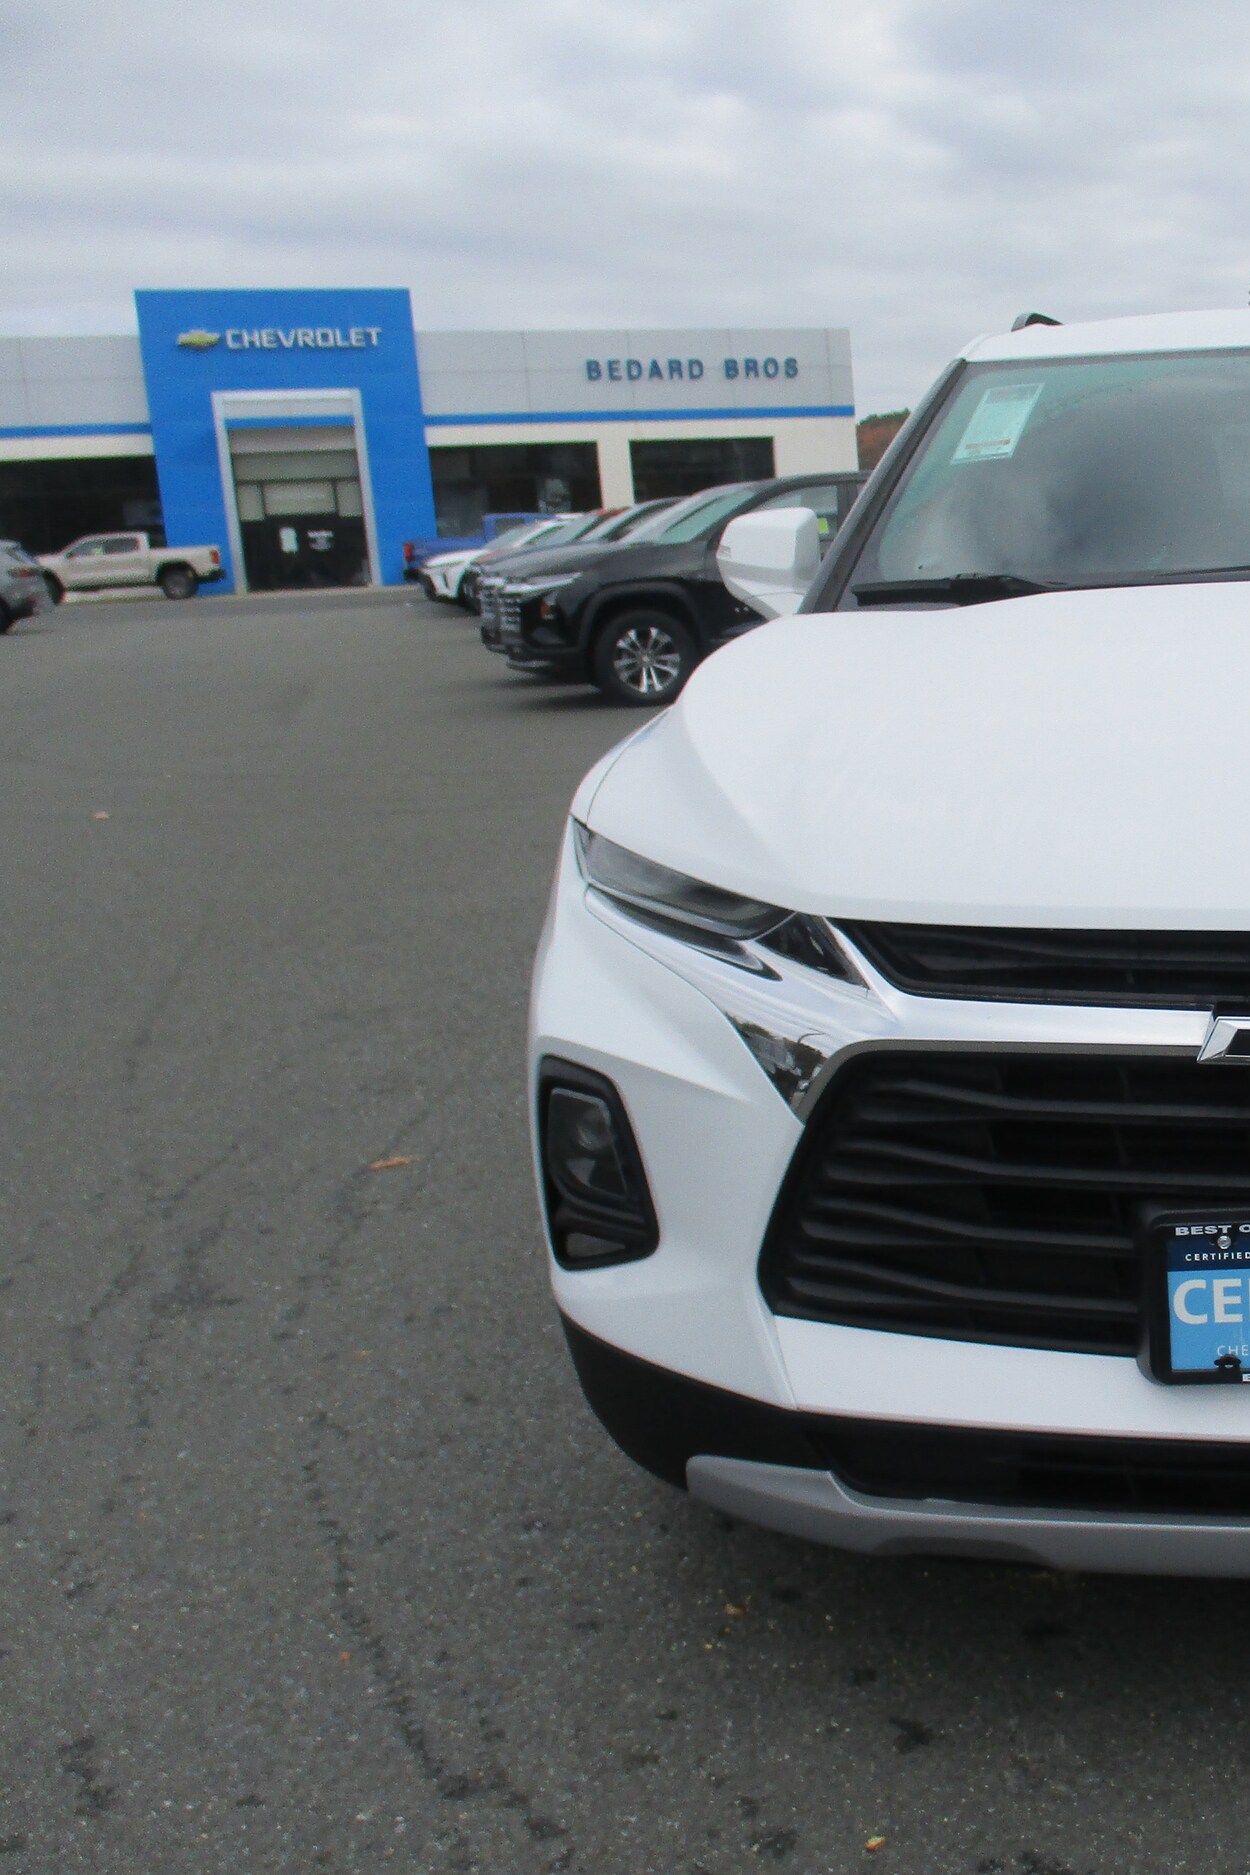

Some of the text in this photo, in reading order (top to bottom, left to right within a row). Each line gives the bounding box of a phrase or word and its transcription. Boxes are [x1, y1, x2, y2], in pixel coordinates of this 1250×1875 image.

[225, 326, 382, 349] CHEVROLET
[586, 356, 799, 381] BEDARD BROS
[1175, 1224, 1232, 1236] BEST
